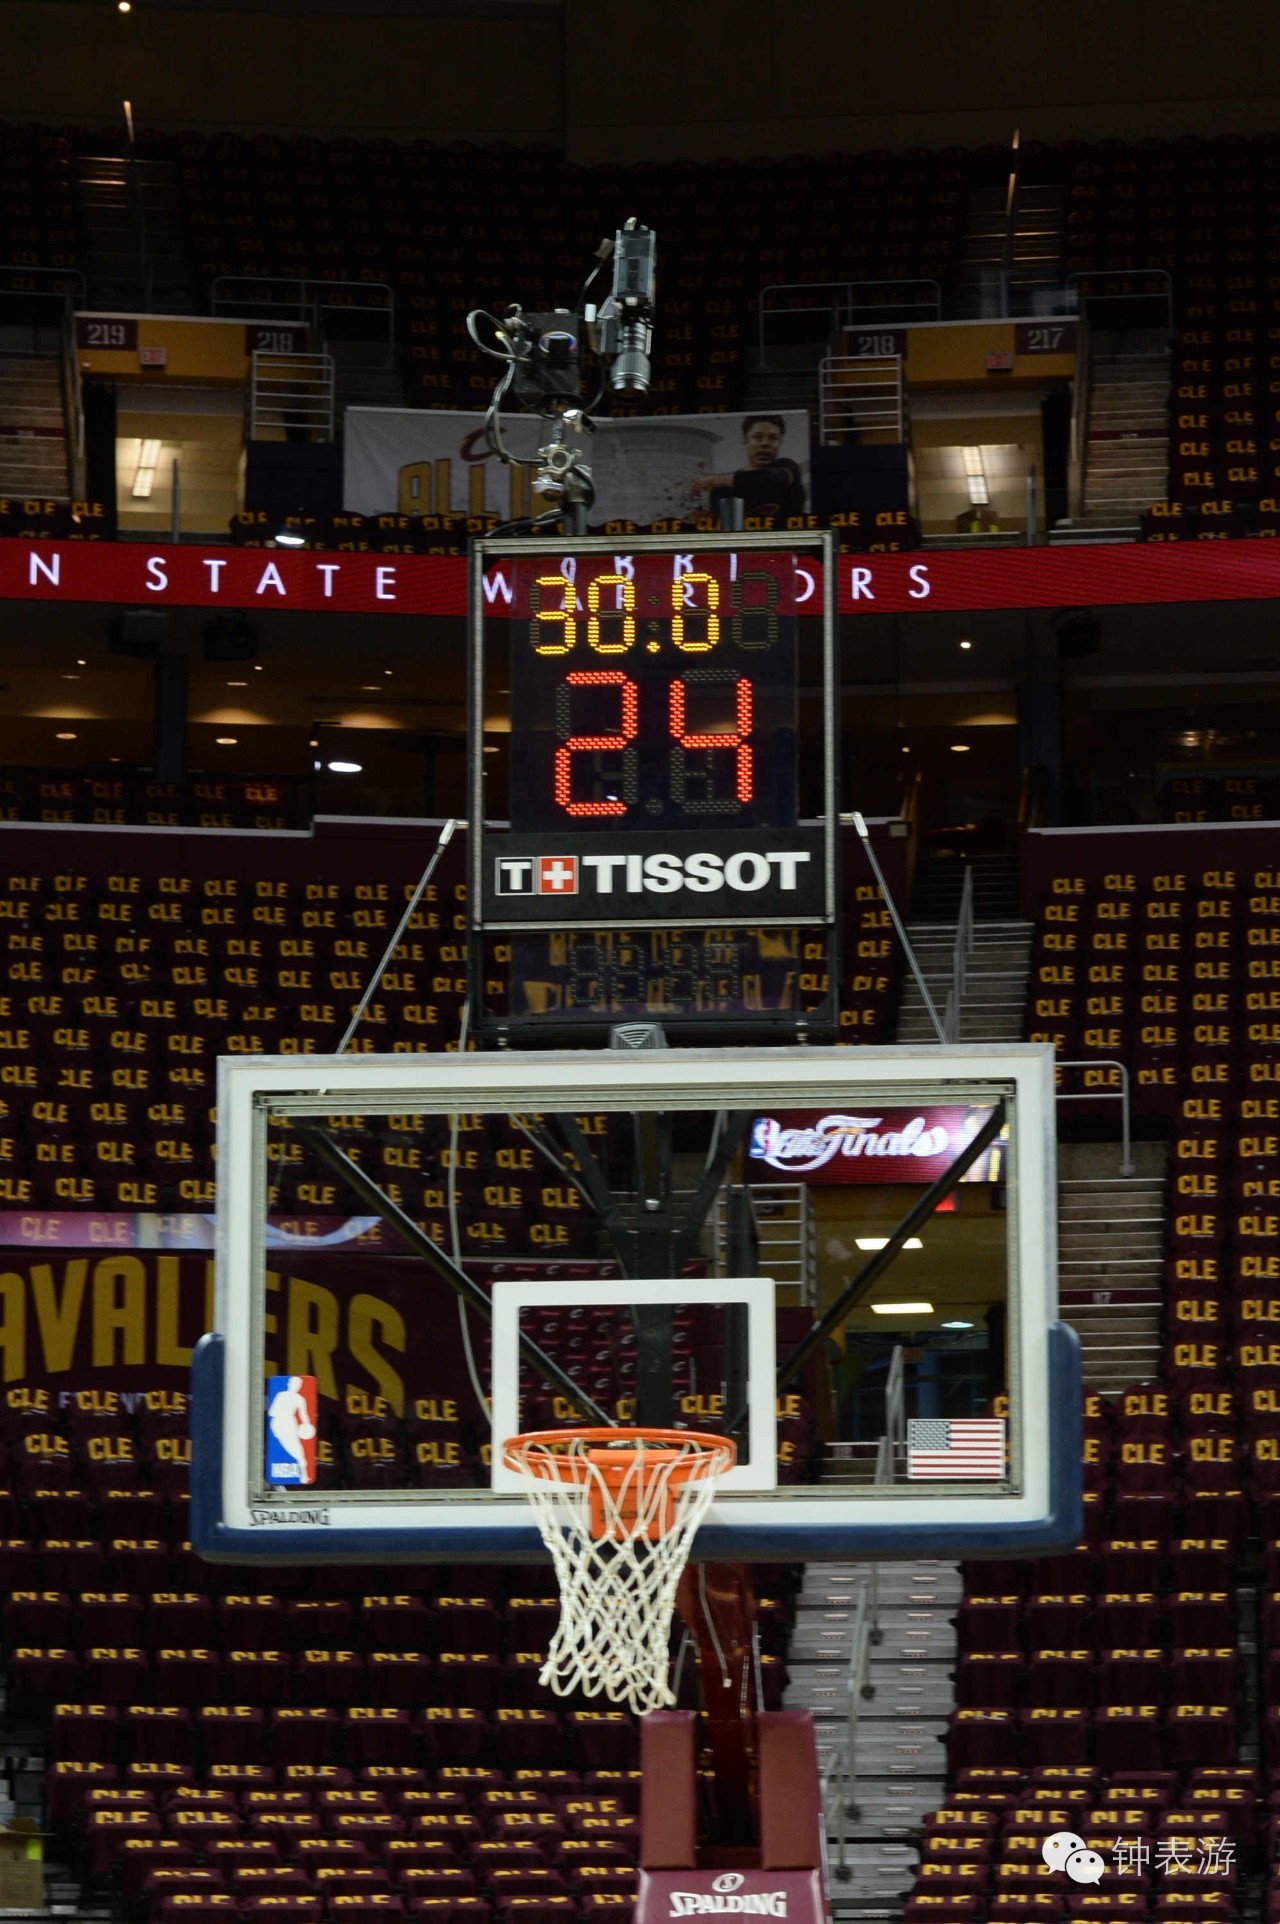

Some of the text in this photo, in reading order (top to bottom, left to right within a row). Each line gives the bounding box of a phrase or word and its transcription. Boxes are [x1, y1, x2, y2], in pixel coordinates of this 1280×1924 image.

[87, 324, 125, 346] 219
[256, 331, 294, 353] 218
[1027, 327, 1064, 349] 217
[857, 335, 896, 356] 218
[876, 512, 905, 526] CLE
[146, 557, 396, 600] STATE
[534, 572, 720, 655] 30.0
[554, 671, 752, 817] 24
[582, 851, 811, 894] TISSOT
[1203, 871, 1233, 887] CLE
[9, 877, 39, 891] CLE
[108, 876, 139, 892] CLE
[159, 877, 189, 892] CLE
[205, 880, 235, 895] CLE
[256, 881, 287, 897] CLE
[306, 884, 337, 899] CLE
[1052, 879, 1083, 893] CLE
[1104, 875, 1133, 890] CLE
[1153, 874, 1184, 891] CLE
[355, 884, 387, 900] CLE
[99, 904, 130, 921] CLE
[149, 903, 180, 920] CLE
[202, 908, 233, 925] CLE
[253, 906, 284, 923] CLE
[1045, 905, 1077, 922] CLE
[1097, 902, 1128, 918] CLE
[1147, 902, 1179, 918] CLE
[1197, 900, 1229, 918] CLE
[302, 911, 333, 927] CLE
[353, 910, 385, 927] CLE
[64, 934, 95, 950] CLE
[175, 939, 207, 955] CLE
[227, 939, 260, 957] CLE
[280, 940, 311, 956] CLE
[335, 940, 367, 957] CLE
[858, 940, 889, 957] CLE
[1043, 934, 1074, 949] CLE
[1093, 933, 1125, 949] CLE
[1146, 933, 1178, 949] CLE
[1196, 931, 1229, 948] CLE
[392, 944, 423, 960] CLE
[9, 961, 41, 979] CLE
[172, 967, 205, 984] CLE
[225, 968, 256, 984] CLE
[1040, 966, 1072, 982] CLE
[1089, 965, 1121, 982] CLE
[1143, 965, 1177, 981] CLE
[1195, 962, 1228, 978] CLE
[1249, 960, 1280, 978] CLE
[279, 971, 310, 988] CLE
[330, 971, 360, 989] CLE
[381, 973, 415, 991] CLE
[83, 997, 116, 1014] CLE
[140, 1000, 174, 1018] CLE
[193, 999, 227, 1017] CLE
[1036, 999, 1070, 1016] CLE
[1088, 996, 1120, 1014] CLE
[1141, 995, 1175, 1012] CLE
[1193, 993, 1227, 1011] CLE
[1246, 992, 1280, 1010] CLE
[300, 1004, 334, 1023] CLE
[403, 1005, 436, 1024] CLE
[54, 1028, 88, 1047] CLE
[111, 1031, 144, 1051] CLE
[1085, 1029, 1119, 1046] CLE
[1141, 1026, 1175, 1044] CLE
[1194, 1025, 1228, 1043] CLE
[1249, 1024, 1280, 1041] CLE
[168, 1035, 203, 1054] CLE
[227, 1035, 262, 1052] CLE
[0, 1066, 36, 1084] CLE
[112, 1069, 147, 1088] CLE
[1084, 1069, 1119, 1086] CLE
[1191, 1064, 1227, 1082] CLE
[33, 1102, 67, 1122] CLE
[90, 1103, 126, 1121] CLE
[148, 1104, 183, 1121] CLE
[1183, 1099, 1220, 1118] CLE
[1241, 1099, 1278, 1118] CLE
[388, 1113, 422, 1131] CLE
[97, 1141, 133, 1161] CLE
[156, 1140, 192, 1160] CLE
[266, 1143, 301, 1161] CLE
[1178, 1140, 1216, 1158] CLE
[1239, 1136, 1277, 1157] CLE
[384, 1147, 419, 1168] CLE
[496, 1149, 532, 1168] CLE
[55, 1178, 93, 1199] CLE
[119, 1182, 156, 1203] CLE
[180, 1180, 214, 1199] CLE
[1178, 1175, 1216, 1194] CLE
[298, 1184, 335, 1204] CLE
[484, 1186, 521, 1206] CLE
[542, 1188, 579, 1207] CLE
[530, 1224, 567, 1244] CLE
[1175, 1215, 1215, 1235] CLE
[1239, 1216, 1277, 1236] CLE
[1176, 1259, 1216, 1280] CLE
[1241, 1256, 1280, 1276] CLE
[1177, 1300, 1216, 1320] CLE
[1242, 1299, 1280, 1321] CLE
[1174, 1344, 1216, 1366] CLE
[1240, 1345, 1280, 1366] CLE
[8, 1388, 47, 1409] CLE
[77, 1390, 117, 1411] CLE
[146, 1390, 185, 1411] CLE
[681, 1394, 722, 1416] CLE
[1125, 1394, 1166, 1415] CLE
[1190, 1393, 1231, 1415] CLE
[416, 1399, 457, 1421] CLE
[26, 1434, 69, 1456] CLE
[88, 1437, 132, 1460] CLE
[352, 1438, 394, 1459] CLE
[416, 1442, 459, 1464] CLE
[1122, 1443, 1164, 1464] CLE
[1190, 1438, 1232, 1462] CLE
[249, 1508, 331, 1527] SPALDING
[669, 1891, 788, 1918] SPALDING
